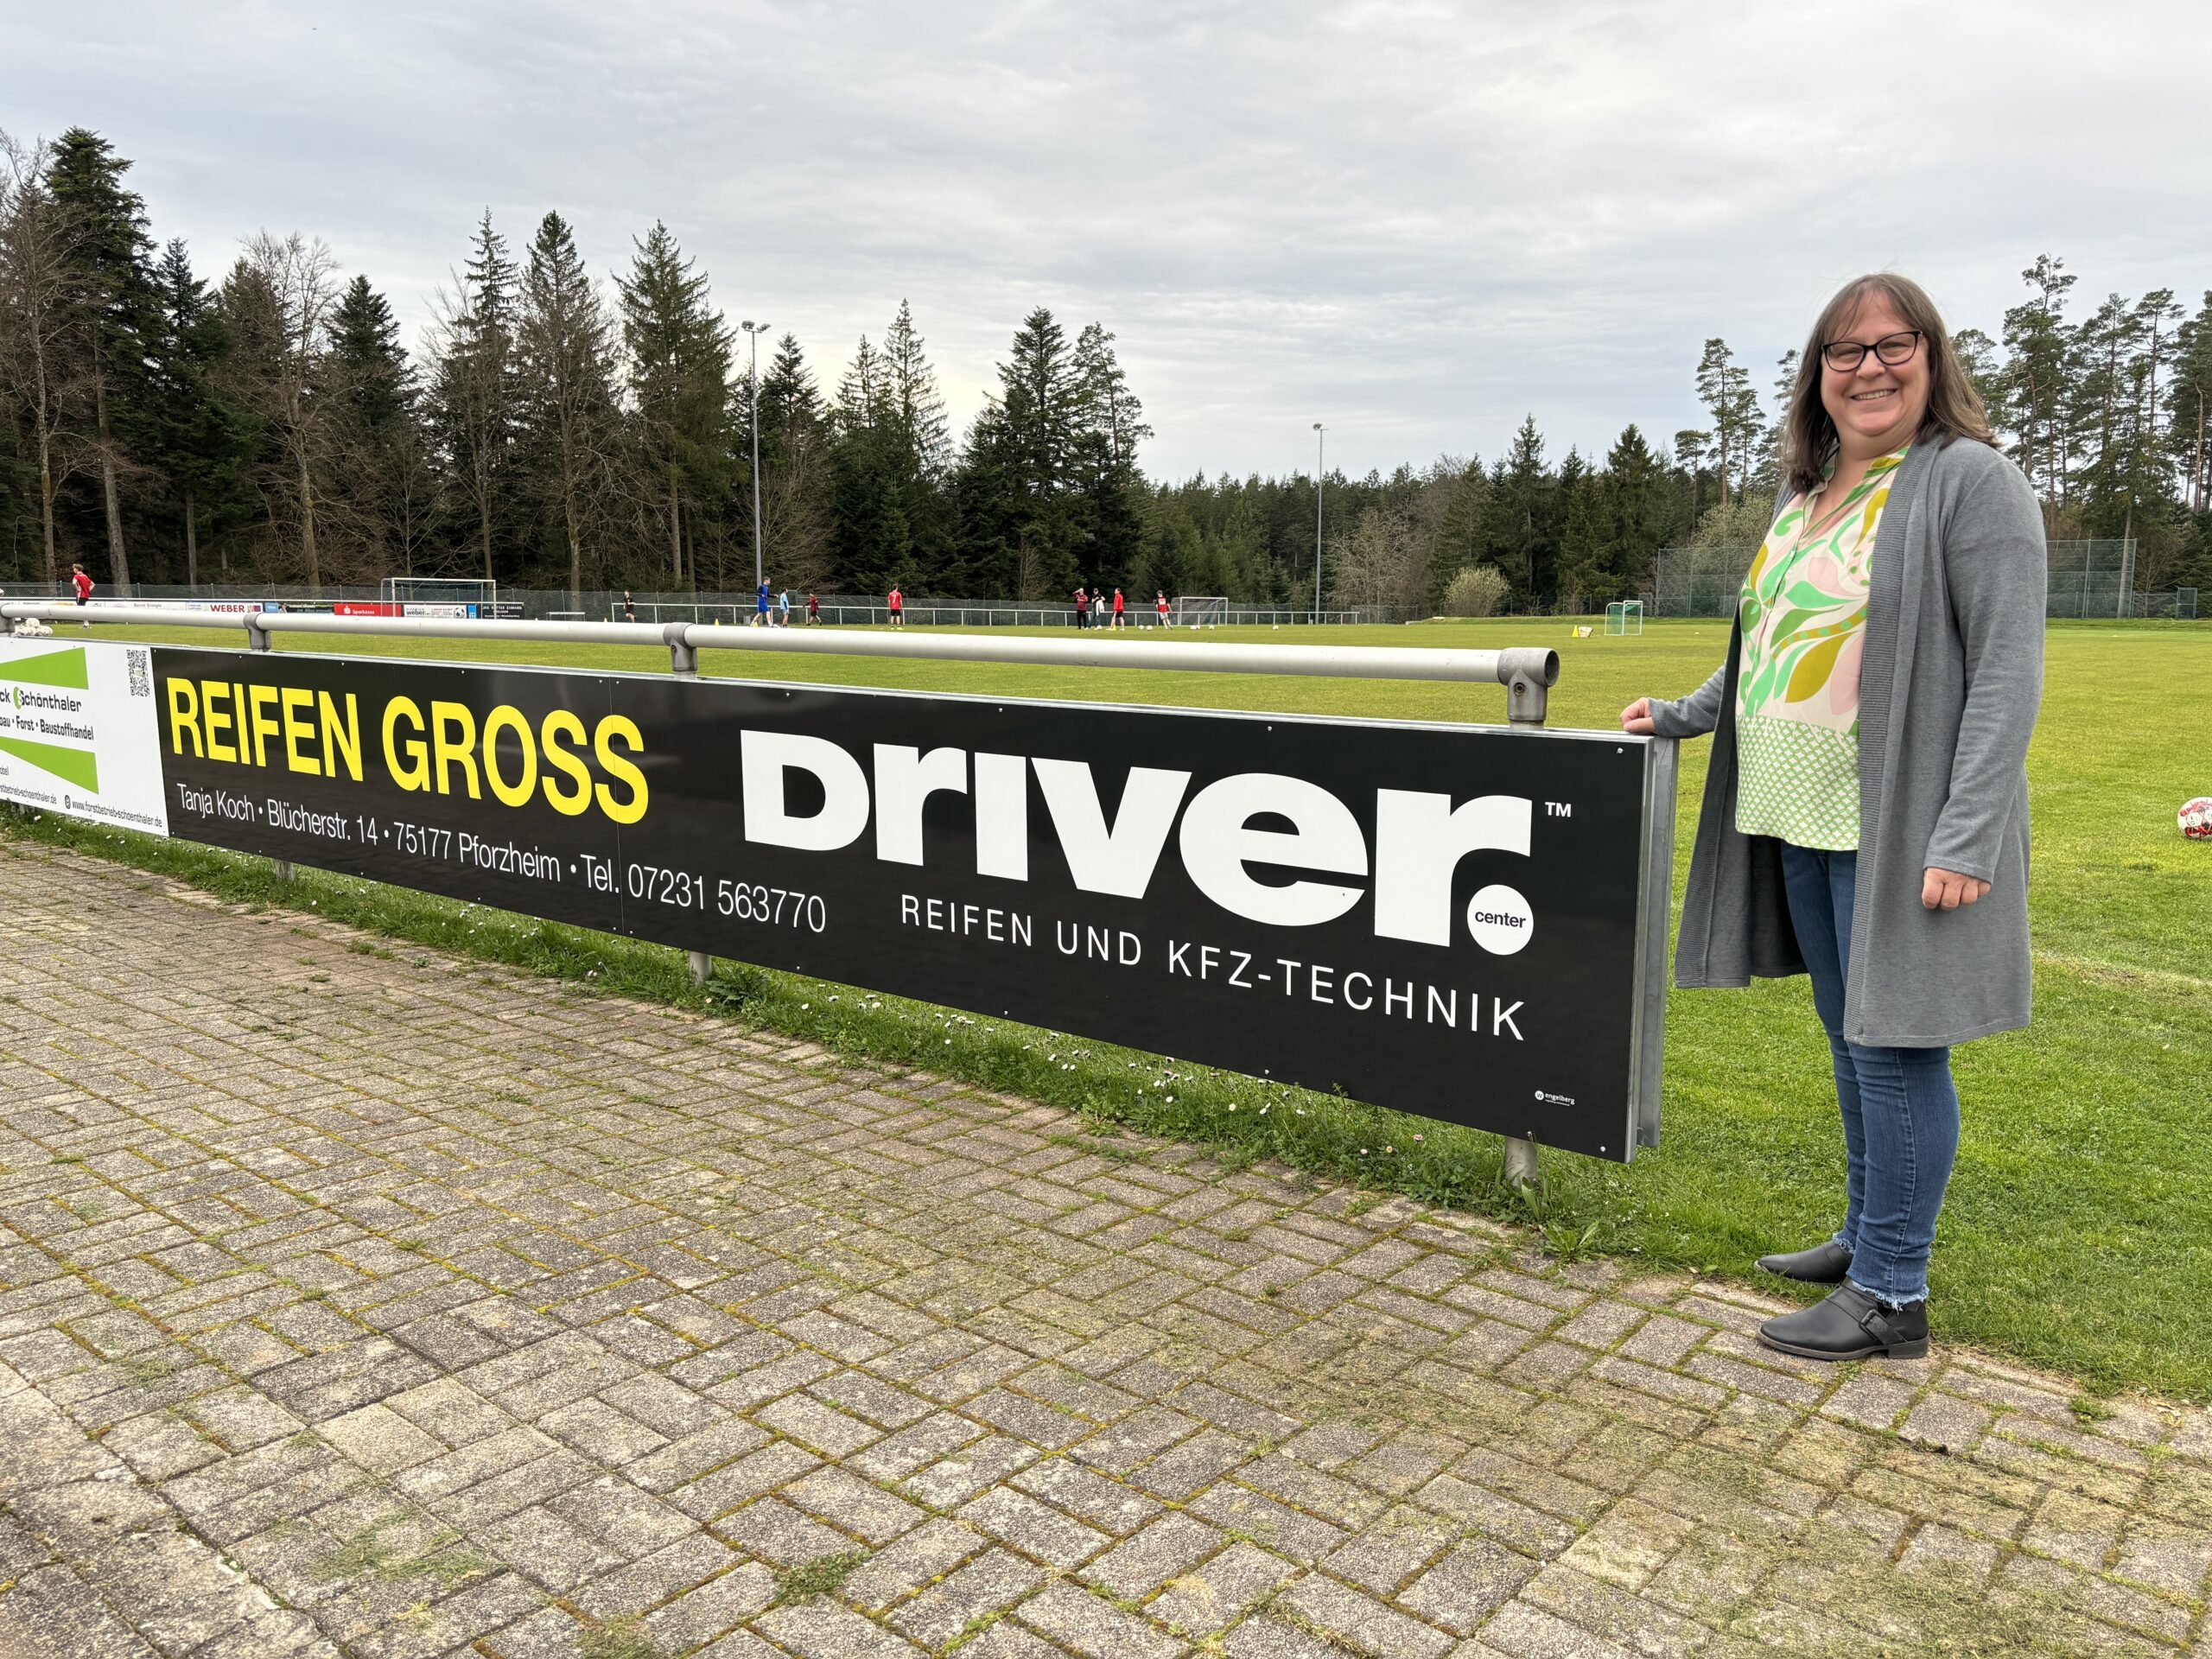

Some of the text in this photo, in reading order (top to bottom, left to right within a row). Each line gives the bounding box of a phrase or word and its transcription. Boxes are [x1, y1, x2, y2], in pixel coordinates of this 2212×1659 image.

[14, 687, 82, 713] Schönthaler
[16, 715, 35, 732] Forst
[40, 719, 94, 741] Baustoffhandel
[167, 677, 648, 823] REIFEN GROSS
[72, 801, 162, 828] www.forstbetrieb-schoenthaler.de
[177, 784, 826, 933] Tanja Koch Blücherstr. 14 75177 Pforzheim Tel. 07231 563770
[1474, 911, 1527, 929] center
[902, 894, 1525, 1041] REIFEN UND KFZ-TECHNIK
[1544, 1093, 1575, 1105] engelberg
